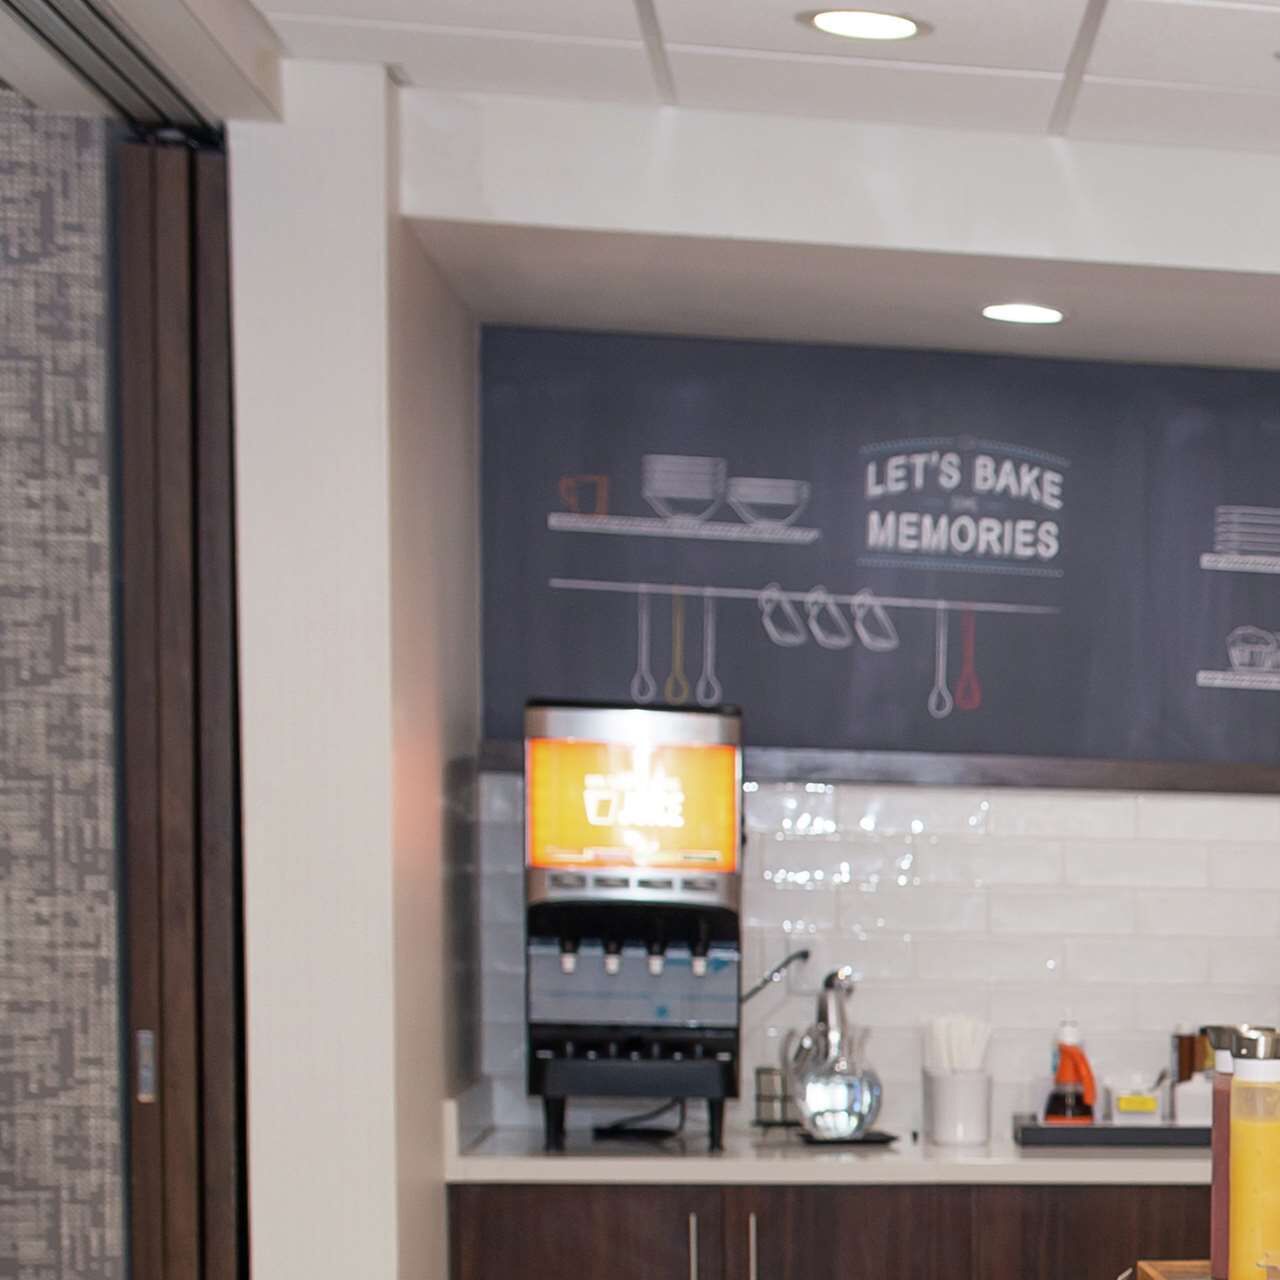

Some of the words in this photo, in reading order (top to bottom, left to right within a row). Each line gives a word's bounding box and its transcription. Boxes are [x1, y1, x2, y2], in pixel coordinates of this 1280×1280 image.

[865, 451, 961, 496] LET'S
[974, 455, 1064, 509] BAKE
[867, 510, 1060, 560] MEMORIES
